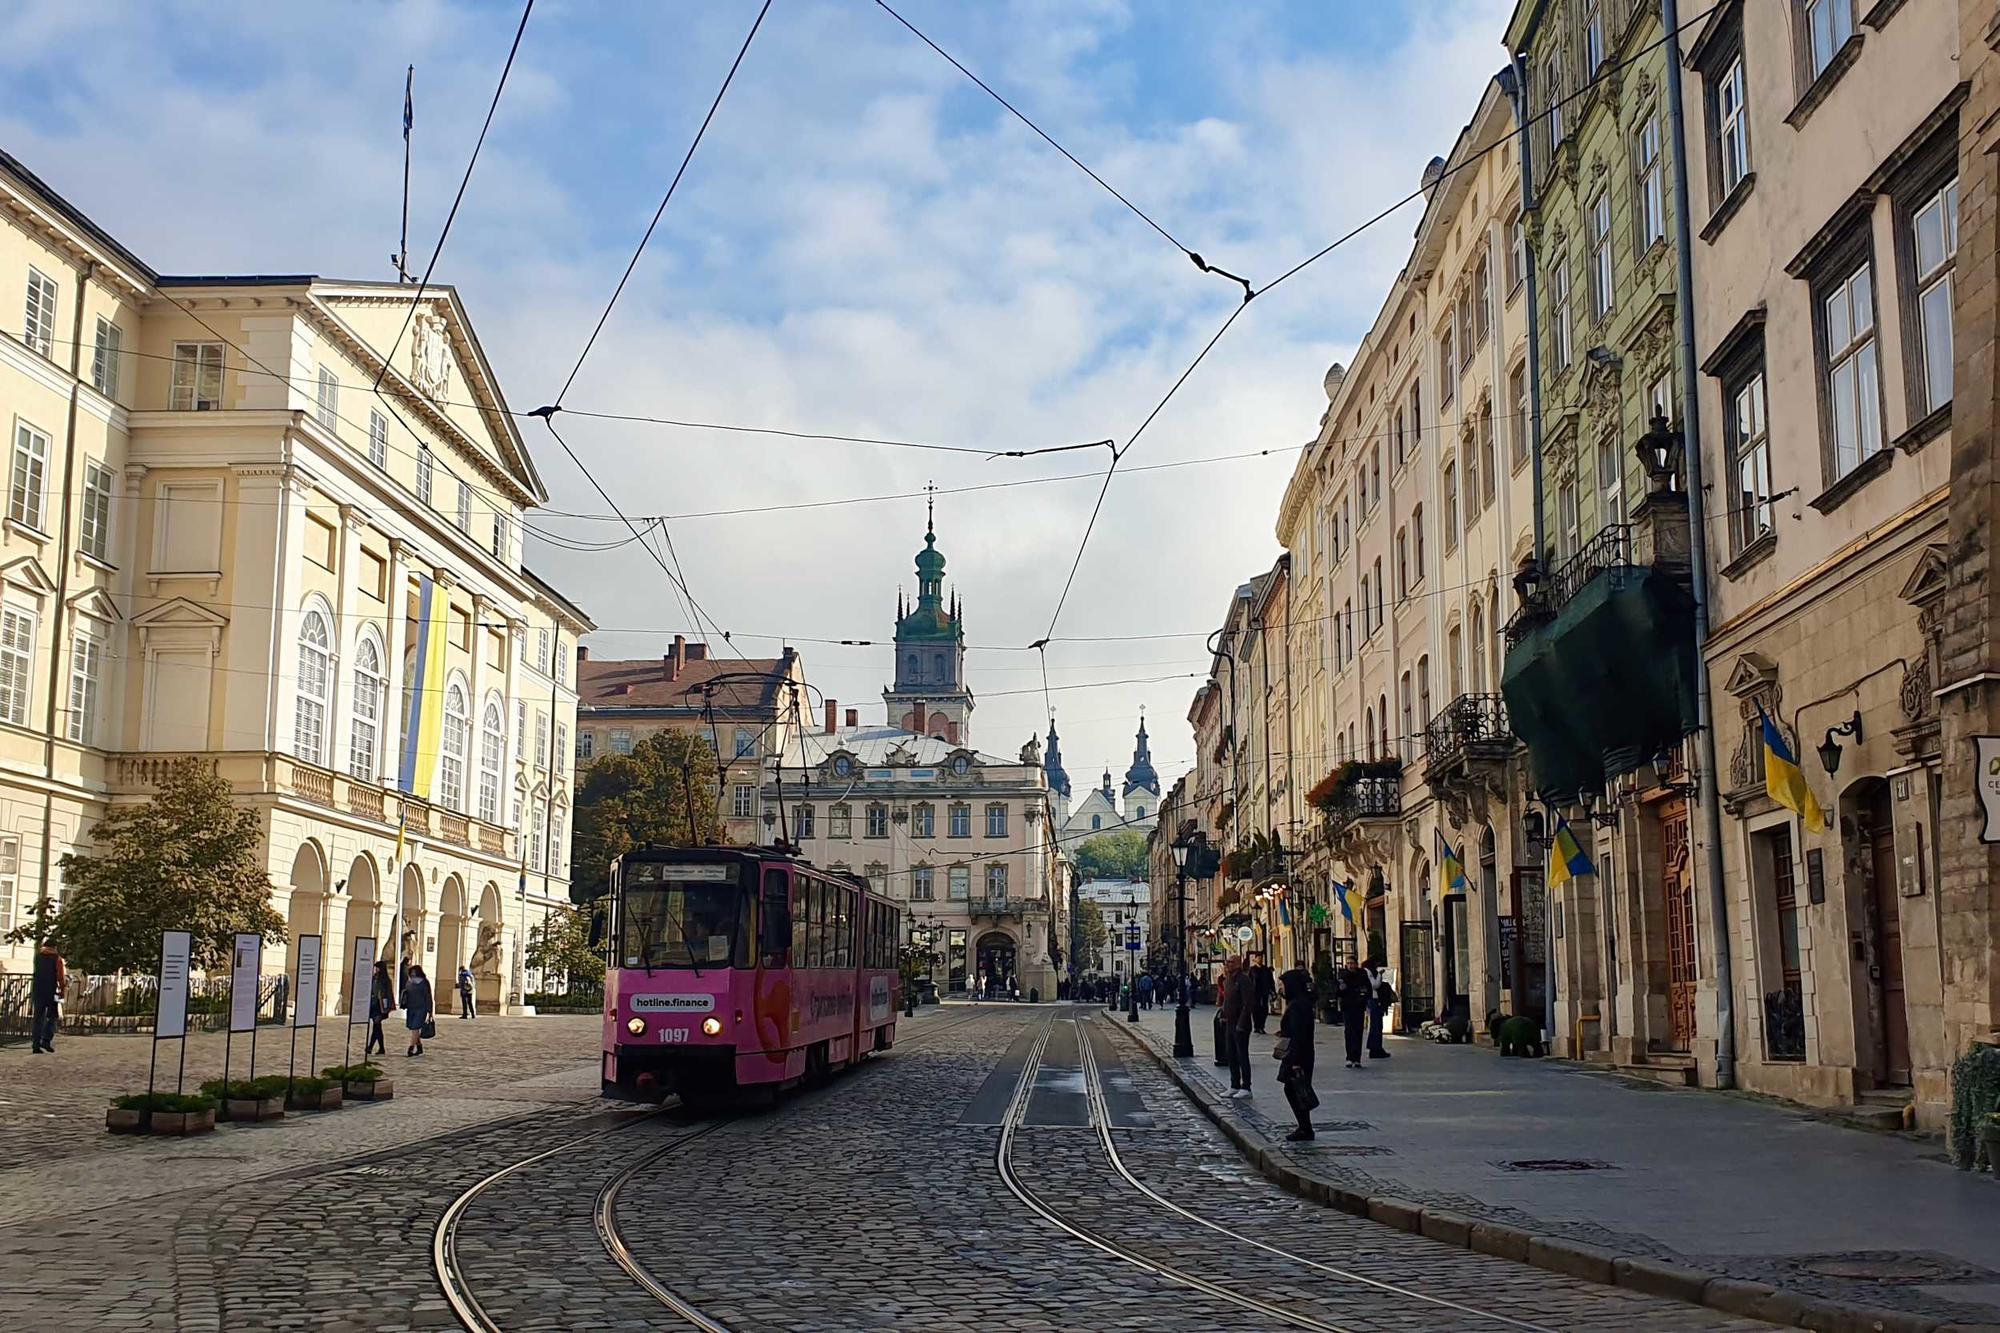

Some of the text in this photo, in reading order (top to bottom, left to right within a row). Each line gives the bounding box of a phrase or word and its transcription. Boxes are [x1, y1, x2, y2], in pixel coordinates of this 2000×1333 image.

[1897, 782, 1905, 797] 21
[644, 866, 652, 875] 2
[636, 998, 709, 1007] hotline.finance
[658, 1028, 689, 1043] 1097
